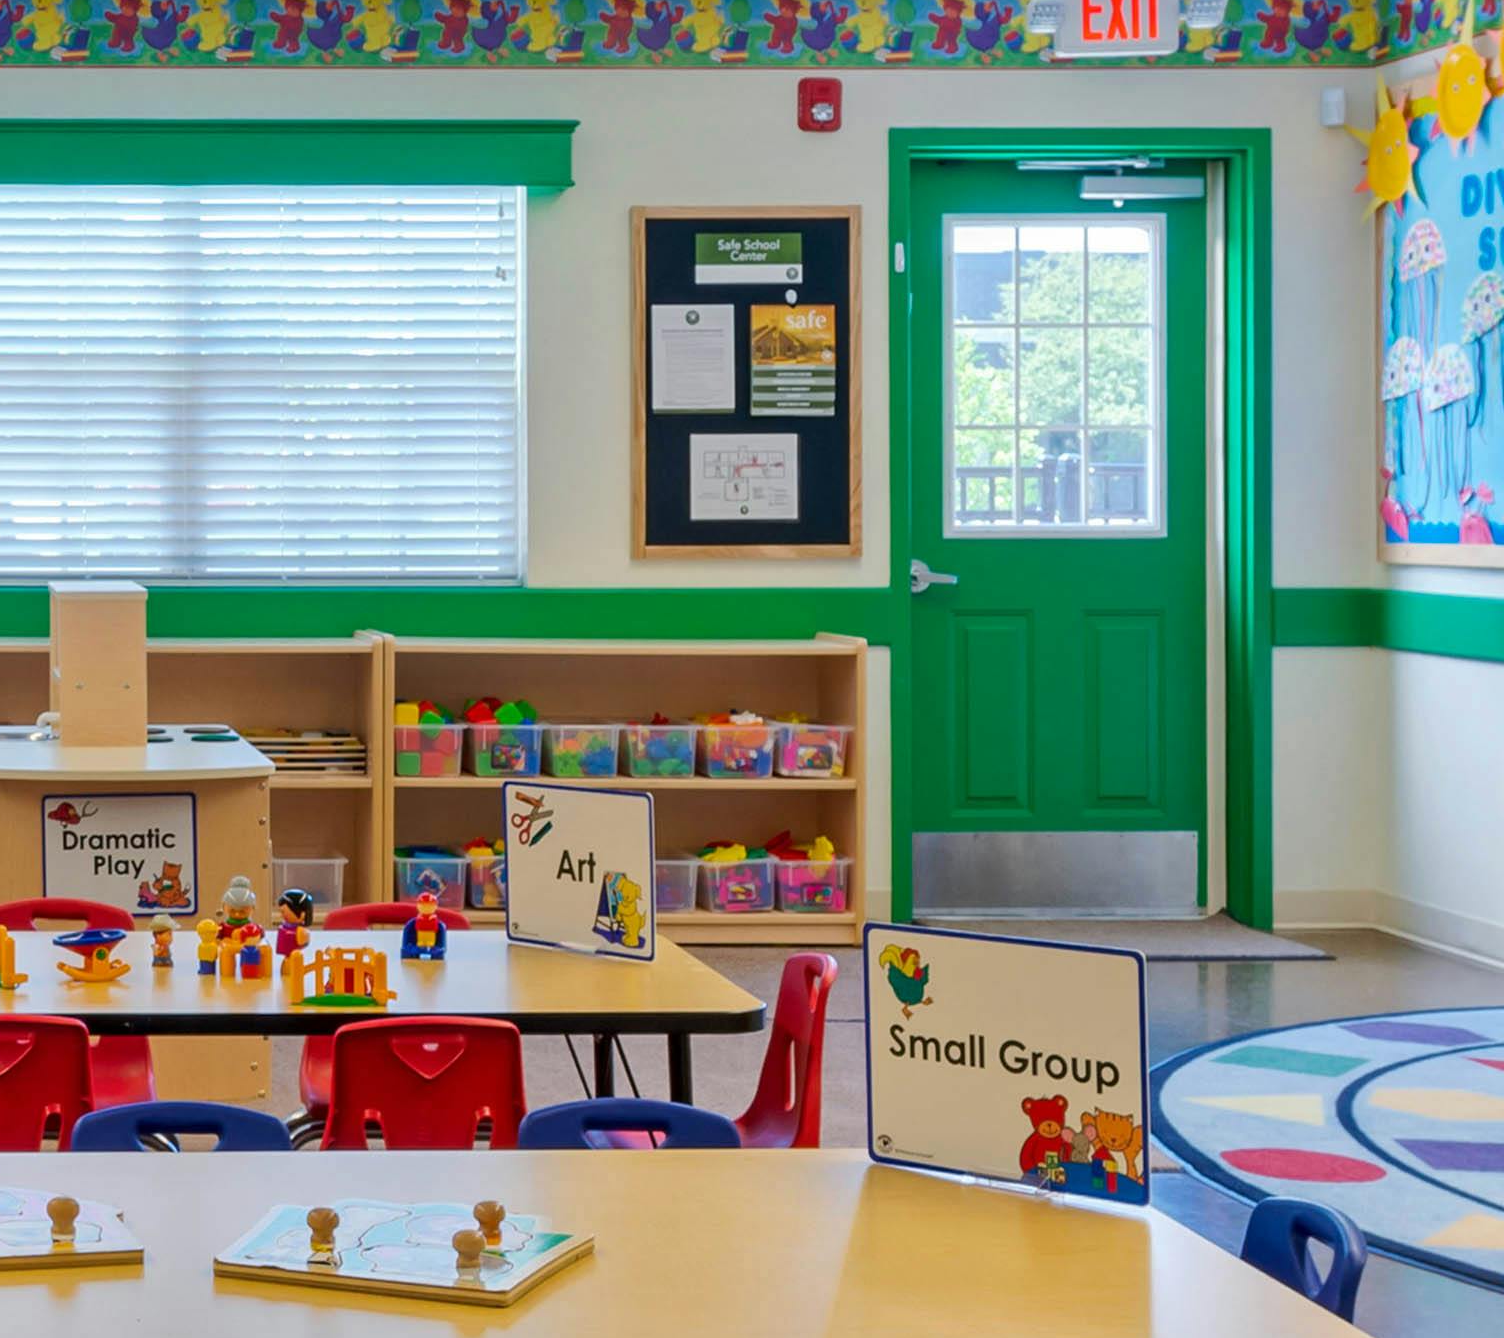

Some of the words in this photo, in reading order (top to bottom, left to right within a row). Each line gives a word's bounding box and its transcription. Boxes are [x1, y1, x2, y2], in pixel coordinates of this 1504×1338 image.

[717, 239, 742, 250] Safe
[744, 239, 781, 250] School
[730, 251, 768, 262] Center
[785, 309, 827, 329] safe
[62, 828, 176, 850] Dramatic
[93, 855, 145, 879] Play
[556, 849, 596, 883] Art
[888, 1024, 986, 1069] Small
[999, 1040, 1120, 1094] Group
